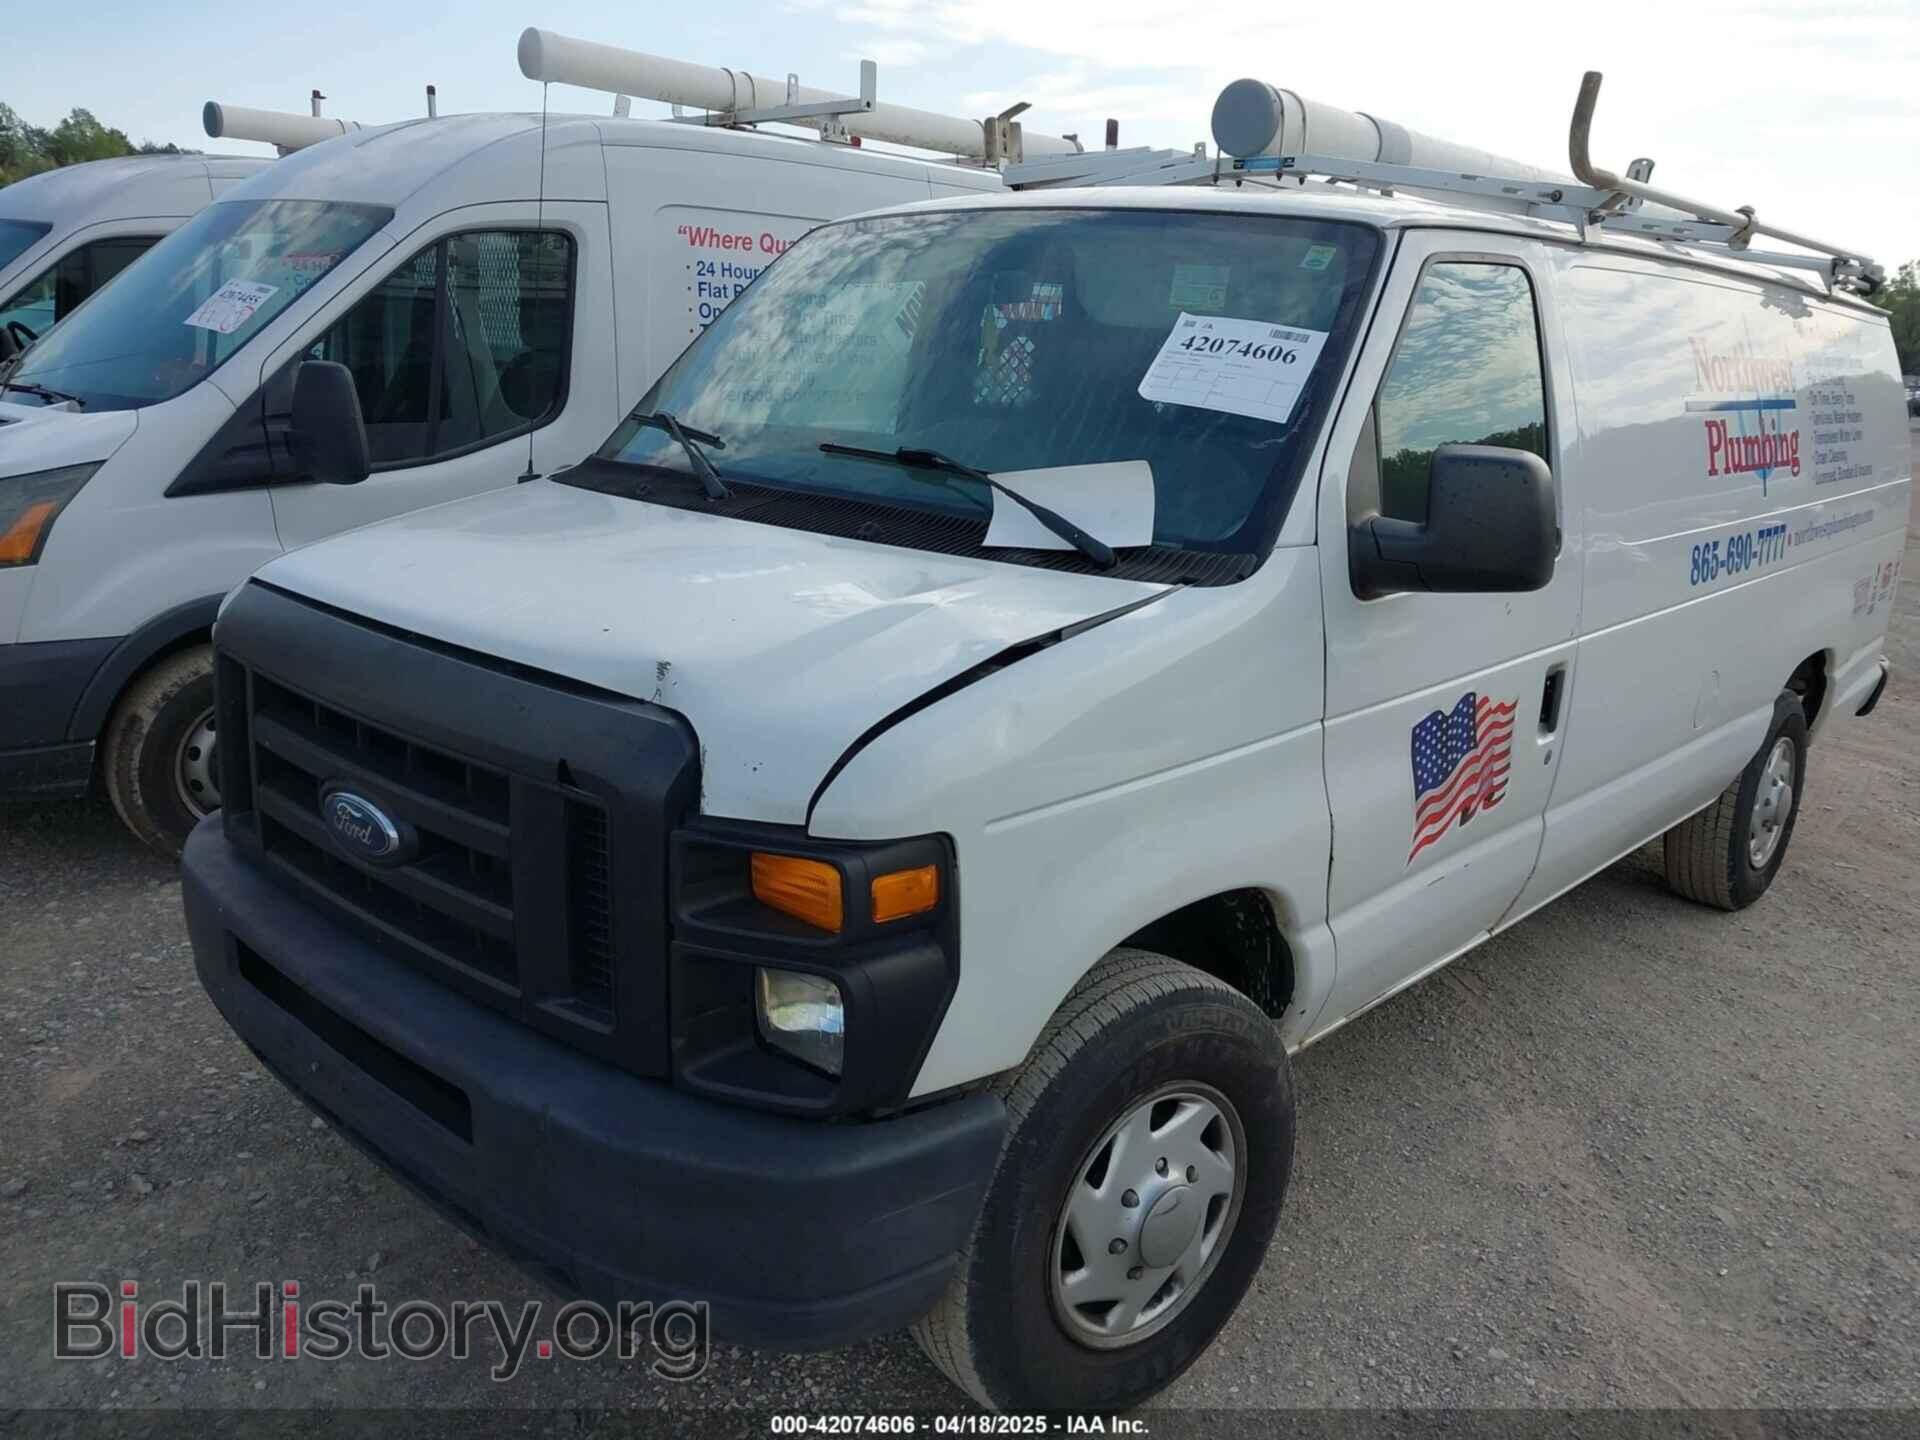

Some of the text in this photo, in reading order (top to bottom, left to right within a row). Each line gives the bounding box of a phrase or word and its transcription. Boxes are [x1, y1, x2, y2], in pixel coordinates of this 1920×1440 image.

[696, 260, 716, 277] 24
[698, 281, 729, 299] Flat
[1180, 335, 1298, 364] 42074606
[1689, 336, 1796, 393] Northwest
[1704, 418, 1800, 477] Plumbing
[1690, 524, 1787, 586] 865-690-7777
[334, 802, 375, 846] Ford
